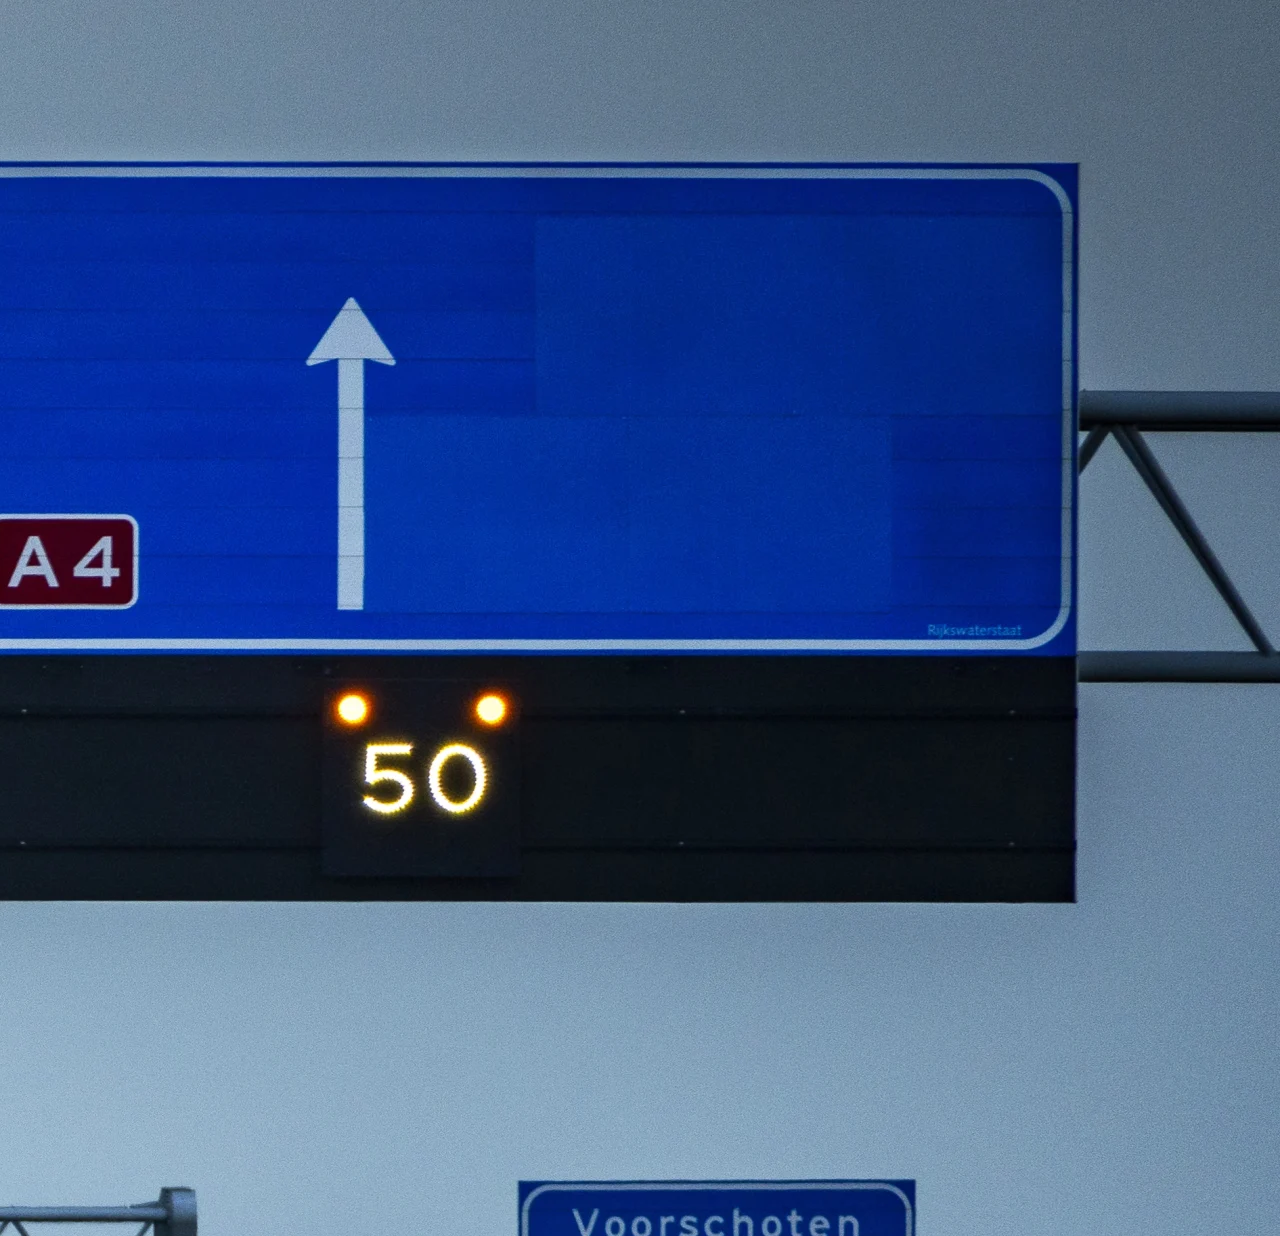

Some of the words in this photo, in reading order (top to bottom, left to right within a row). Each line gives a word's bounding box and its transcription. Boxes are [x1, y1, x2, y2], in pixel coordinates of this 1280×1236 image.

[6, 534, 121, 589] A4
[927, 623, 1023, 639] Rijkswaterstaat
[361, 740, 489, 817] 50
